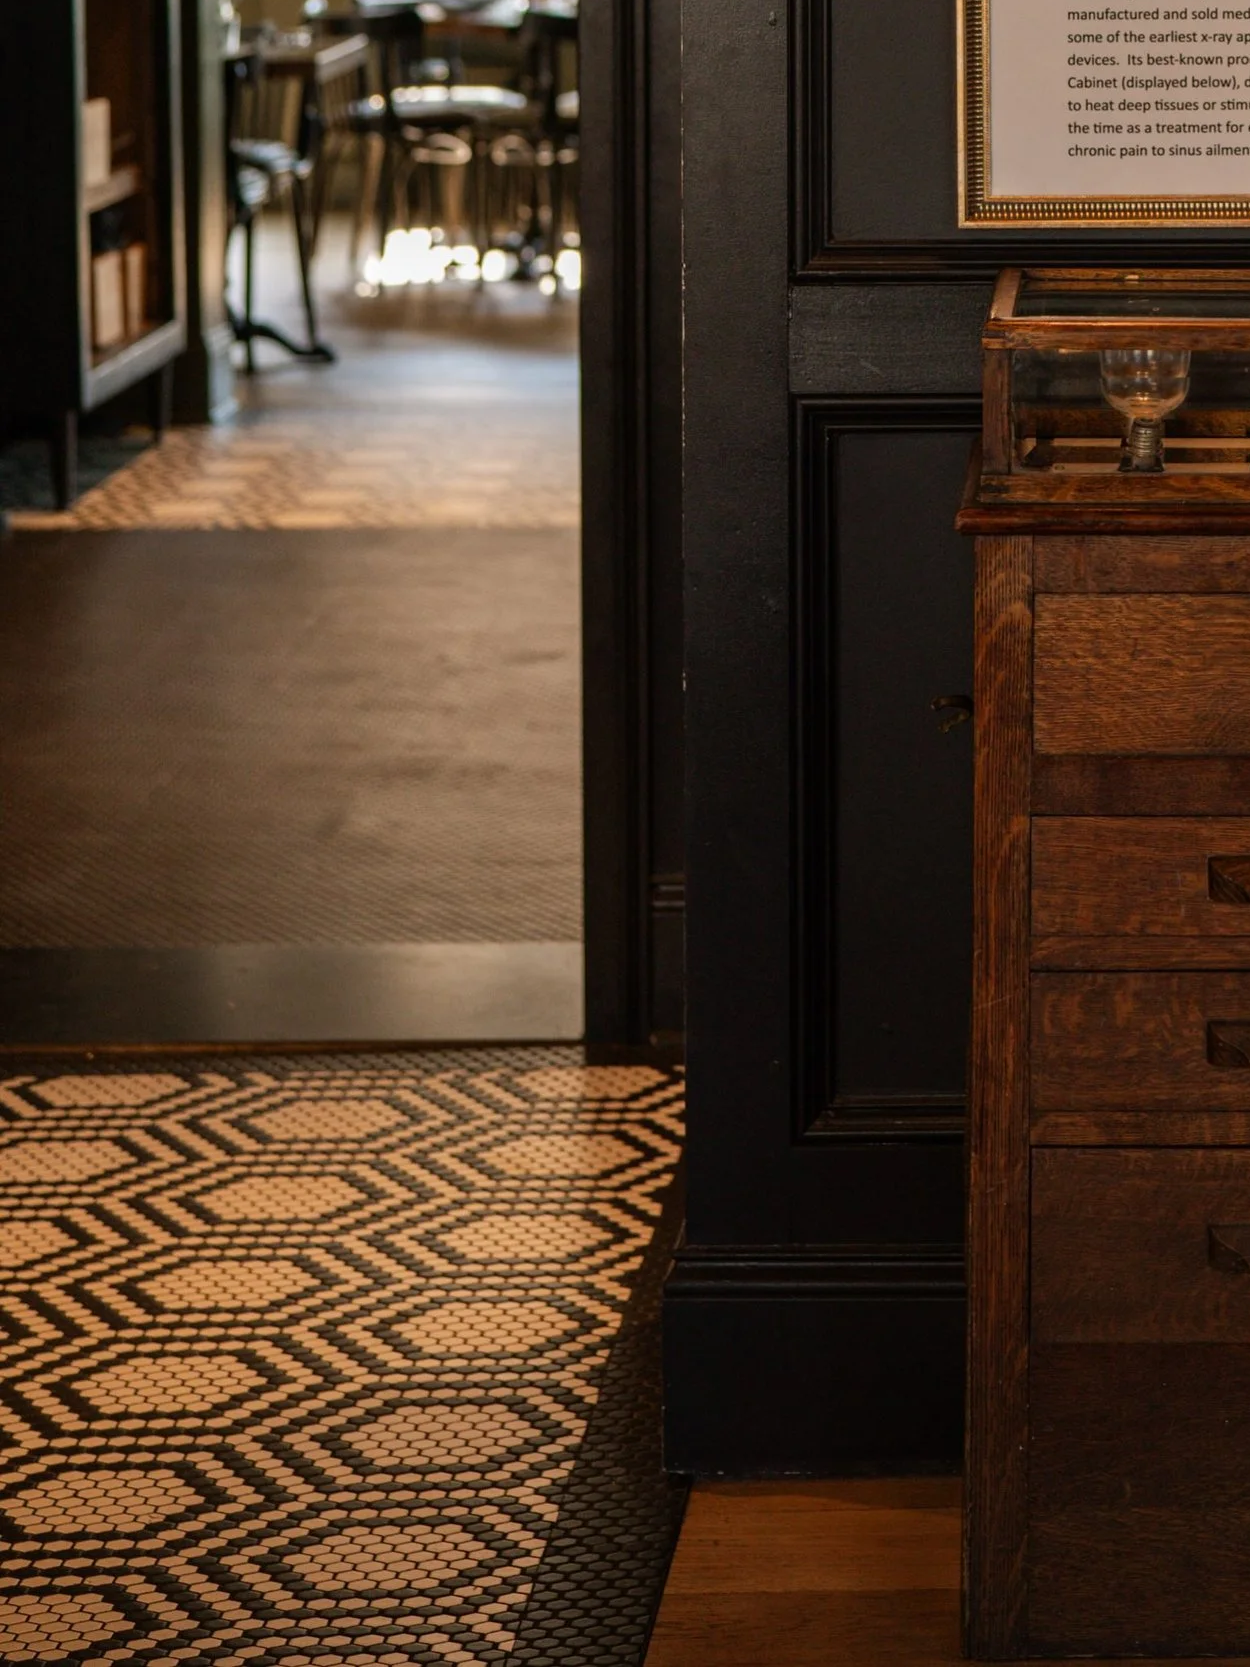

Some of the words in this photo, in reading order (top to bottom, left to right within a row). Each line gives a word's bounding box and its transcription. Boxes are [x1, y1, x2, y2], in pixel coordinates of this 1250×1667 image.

[1067, 6, 1160, 21] manufactured
[1162, 7, 1188, 21] and
[1191, 7, 1219, 21] sold
[1067, 33, 1104, 44] some
[1105, 29, 1121, 44] of
[1122, 30, 1146, 44] the
[1148, 29, 1199, 44] earliest
[1200, 32, 1234, 46] x-ray
[1067, 53, 1120, 67] devices.
[1127, 53, 1144, 67] Its
[1146, 52, 1224, 66] best-known
[1067, 75, 1119, 90] Cabinet
[1121, 75, 1188, 92] (displayed
[1191, 74, 1241, 91] below),
[1067, 100, 1083, 112] to
[1084, 98, 1115, 112] heat
[1117, 98, 1152, 114] deep
[1153, 98, 1200, 112] tissues
[1202, 101, 1218, 111] or
[1067, 121, 1091, 135] the
[1092, 121, 1124, 135] time
[1126, 123, 1142, 135] as
[1143, 124, 1153, 135] a
[1155, 121, 1223, 134] treatment
[1225, 120, 1245, 134] for
[1067, 143, 1117, 158] chronic
[1119, 144, 1148, 160] pain
[1151, 145, 1166, 157] to
[1168, 143, 1203, 157] sinus
